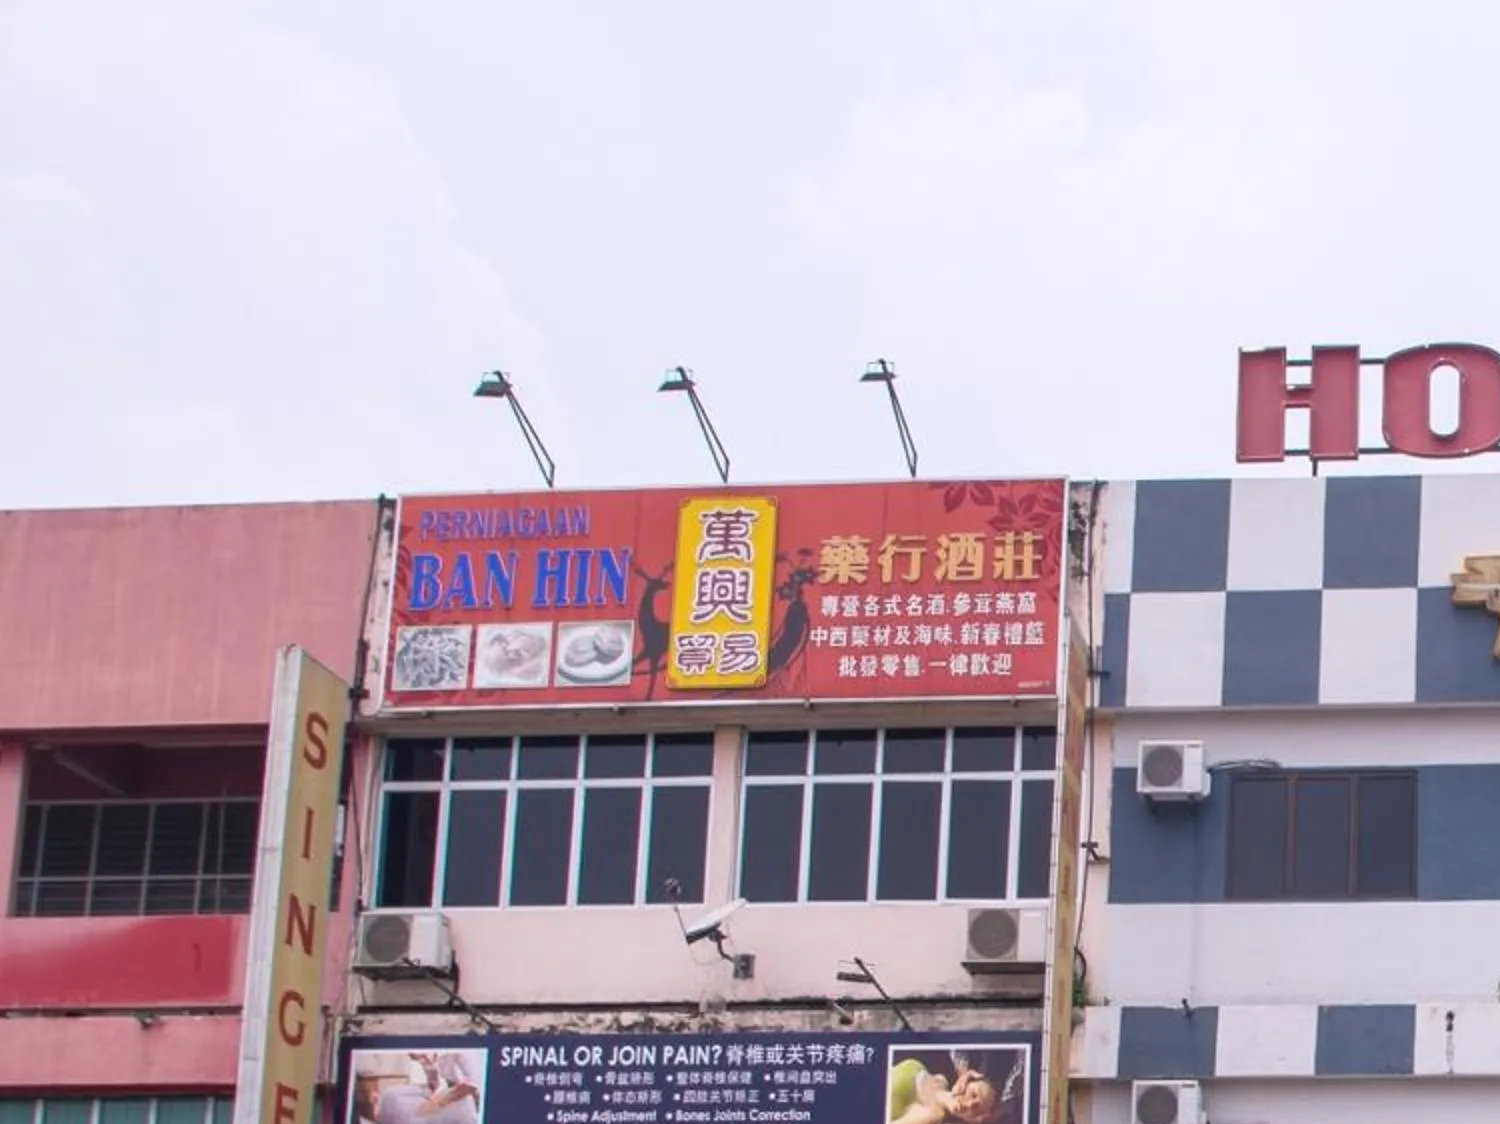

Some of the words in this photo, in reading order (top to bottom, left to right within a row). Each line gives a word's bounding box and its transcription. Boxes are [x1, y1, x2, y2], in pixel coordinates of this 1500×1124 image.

[419, 505, 591, 542] PERNIAGAAN
[818, 531, 1044, 584] 藥行酒莊
[408, 549, 520, 611] BAN
[532, 546, 633, 609] HIN
[501, 1046, 568, 1067] SPINAL
[574, 1045, 603, 1066] OR
[608, 1044, 656, 1066] JOIN
[663, 1044, 723, 1066] PAIN?
[556, 1110, 589, 1123] Spine
[591, 1109, 657, 1124] Adjustment
[675, 1109, 710, 1121] Bones
[713, 1109, 746, 1121] Joints
[750, 1108, 811, 1121] Correction
